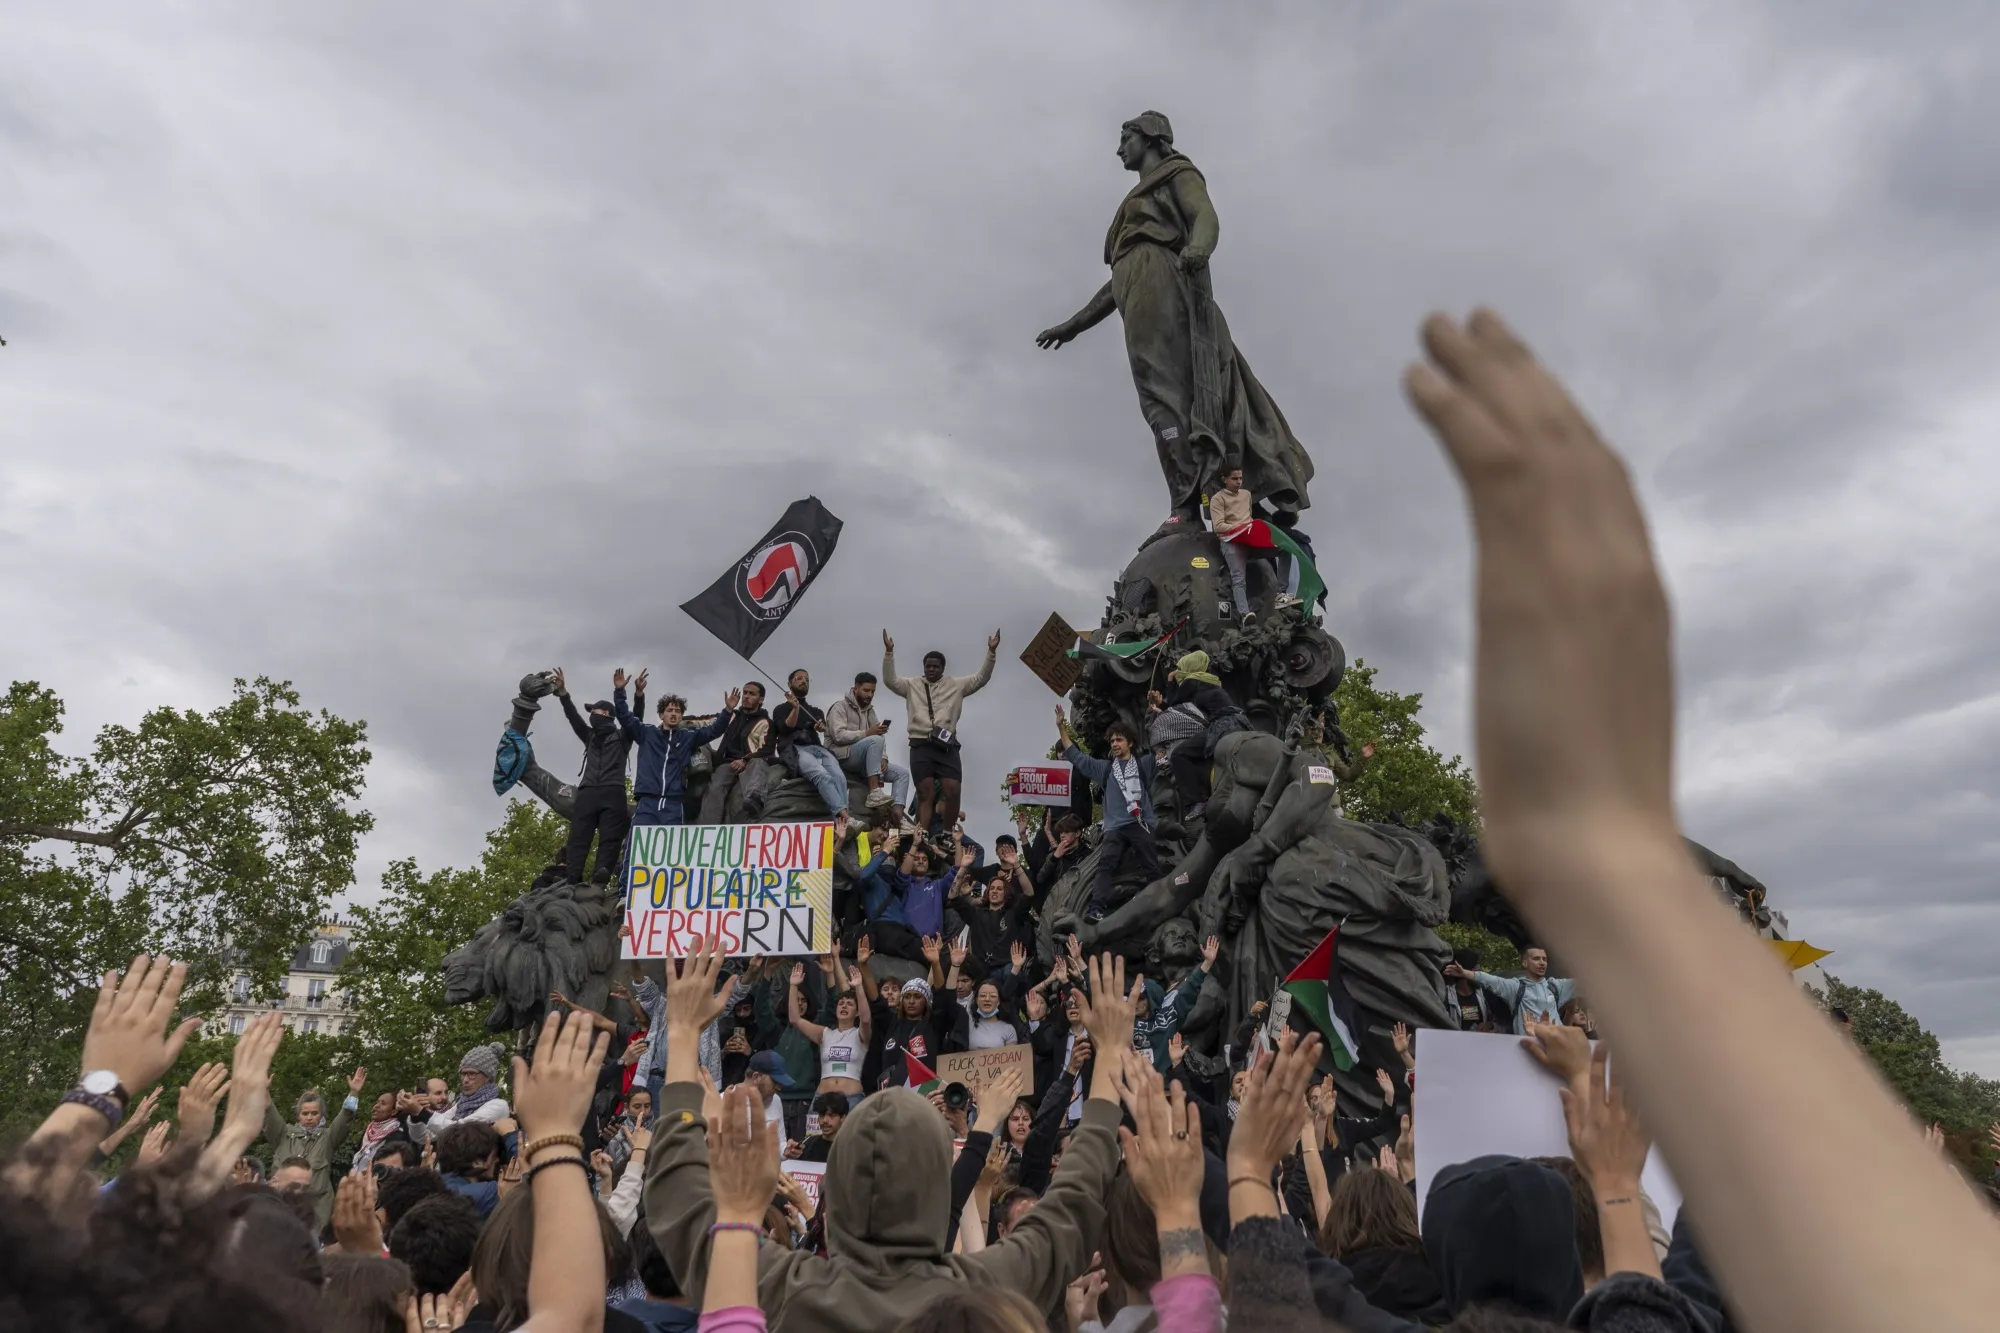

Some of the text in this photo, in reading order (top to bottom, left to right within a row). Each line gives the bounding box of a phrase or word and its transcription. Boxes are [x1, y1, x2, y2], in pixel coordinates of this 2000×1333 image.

[1019, 772, 1048, 784] FRONT
[1019, 782, 1068, 795] POPULAIRE
[630, 823, 833, 870] NOUVEAU FRONT
[627, 907, 815, 956] VERSUS RN
[948, 1050, 1023, 1072] FUCK JORDAN
[987, 1067, 1002, 1079] VA
[792, 1173, 818, 1182] NOUVEAU
